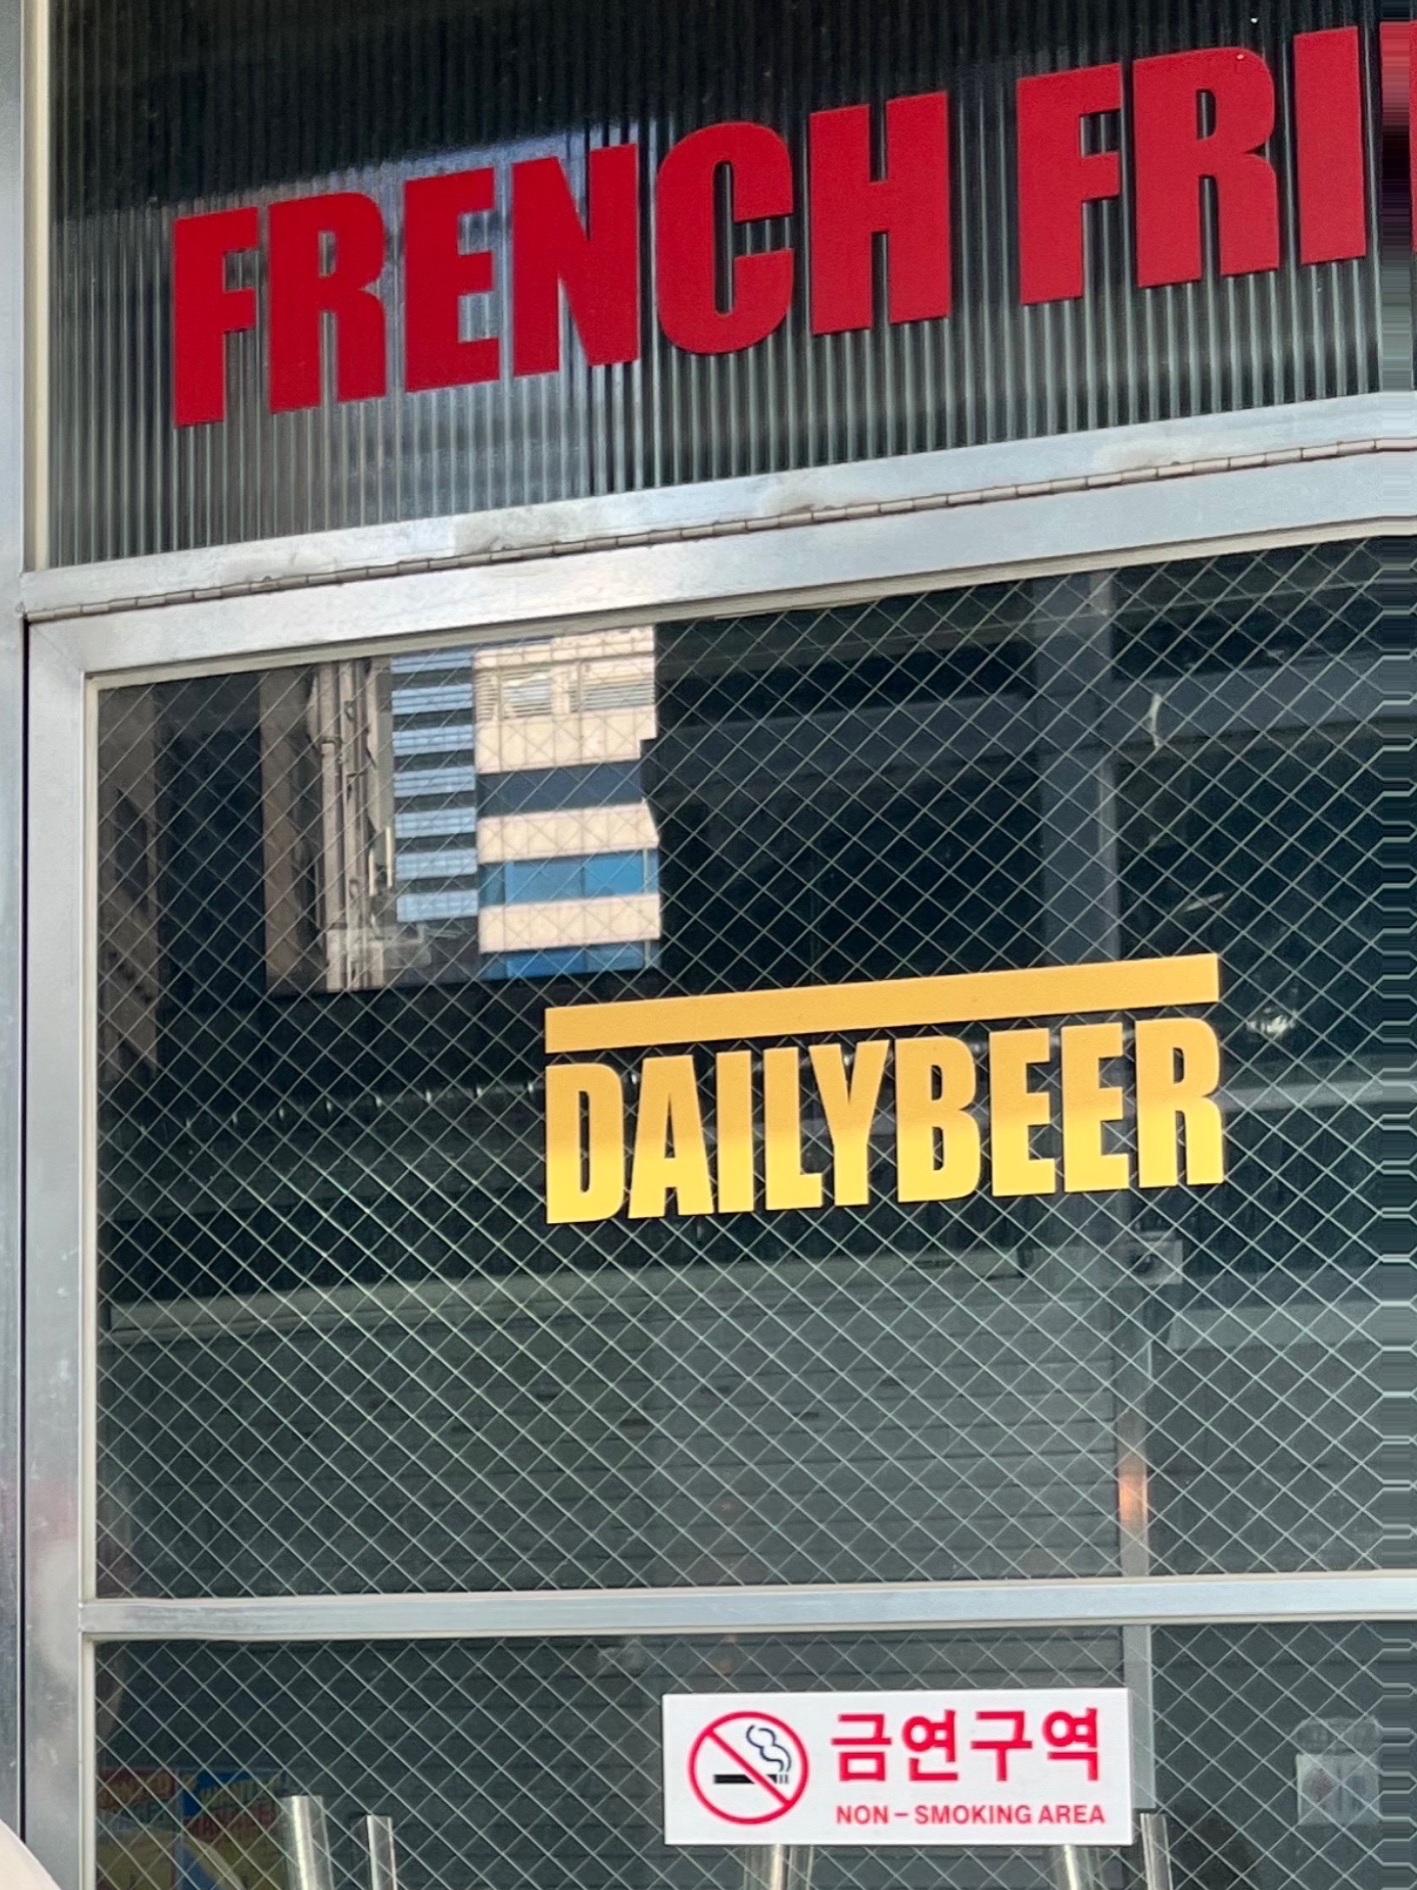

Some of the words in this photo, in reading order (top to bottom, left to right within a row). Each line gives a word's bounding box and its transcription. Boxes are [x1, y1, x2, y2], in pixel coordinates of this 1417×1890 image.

[174, 92, 950, 427] FRENCH
[545, 1017, 1224, 1224] DAILYBEER
[831, 1707, 1099, 1781] 금연구역
[1038, 1805, 1105, 1825] AREA
